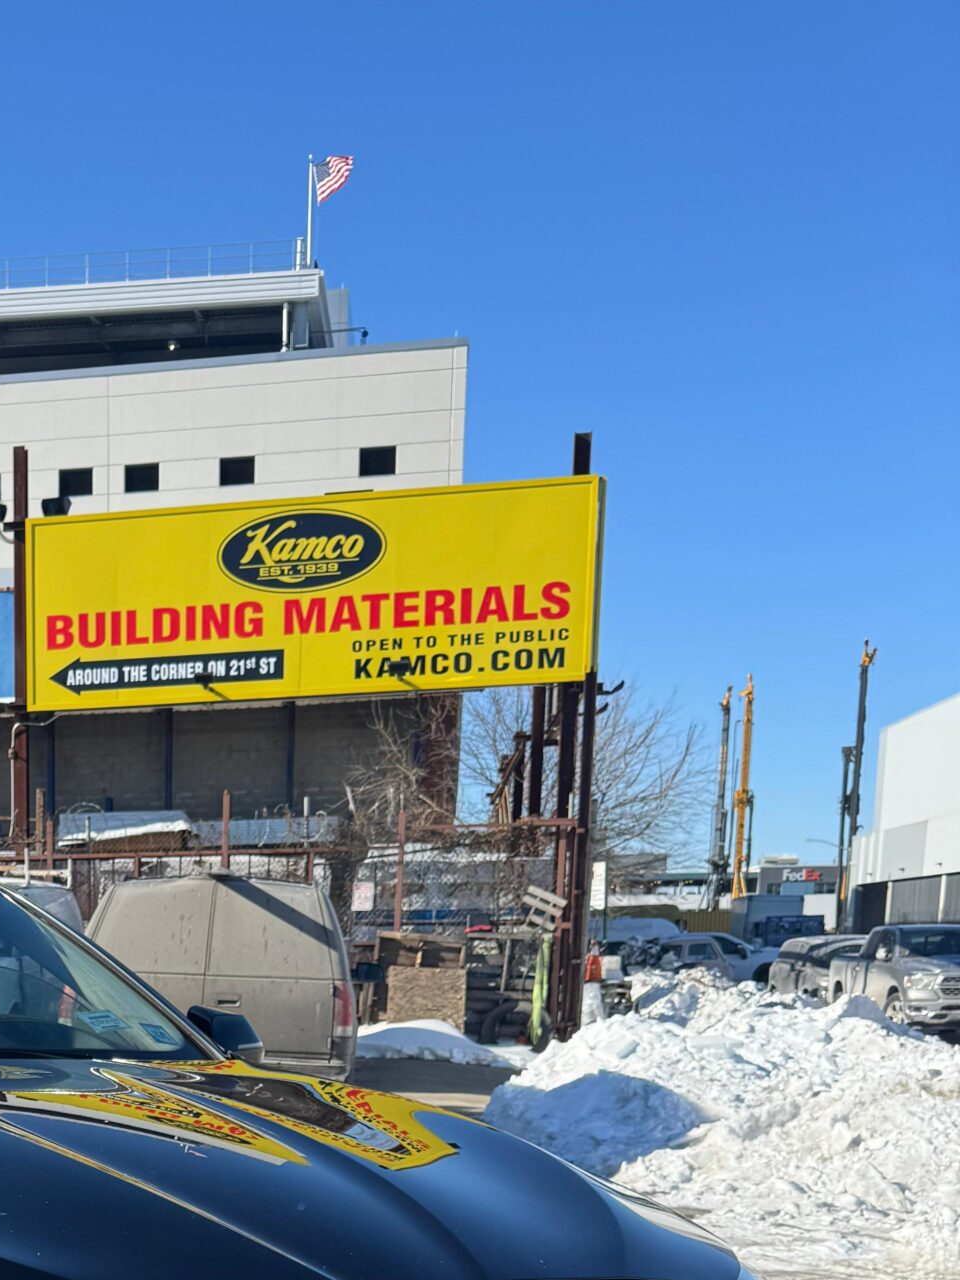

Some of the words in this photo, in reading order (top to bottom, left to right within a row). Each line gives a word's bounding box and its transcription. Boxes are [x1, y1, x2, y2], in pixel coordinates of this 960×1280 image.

[240, 520, 365, 566] Kamco
[259, 566, 294, 578] EST.
[296, 563, 339, 575] 1939
[46, 601, 264, 651] BUILDING
[283, 581, 571, 635] MATERIALS
[352, 638, 403, 653] OPEN
[414, 635, 437, 649] TO
[448, 633, 485, 647] THE
[495, 628, 570, 645] PUBLIC
[66, 667, 119, 687] AROUND
[122, 664, 148, 683] THE
[150, 660, 204, 682] CORNER
[207, 659, 227, 678] ON
[229, 656, 256, 677] 21st
[259, 656, 277, 675] ST
[354, 647, 566, 679] KAMCO.COM
[783, 868, 822, 881] FedEx
